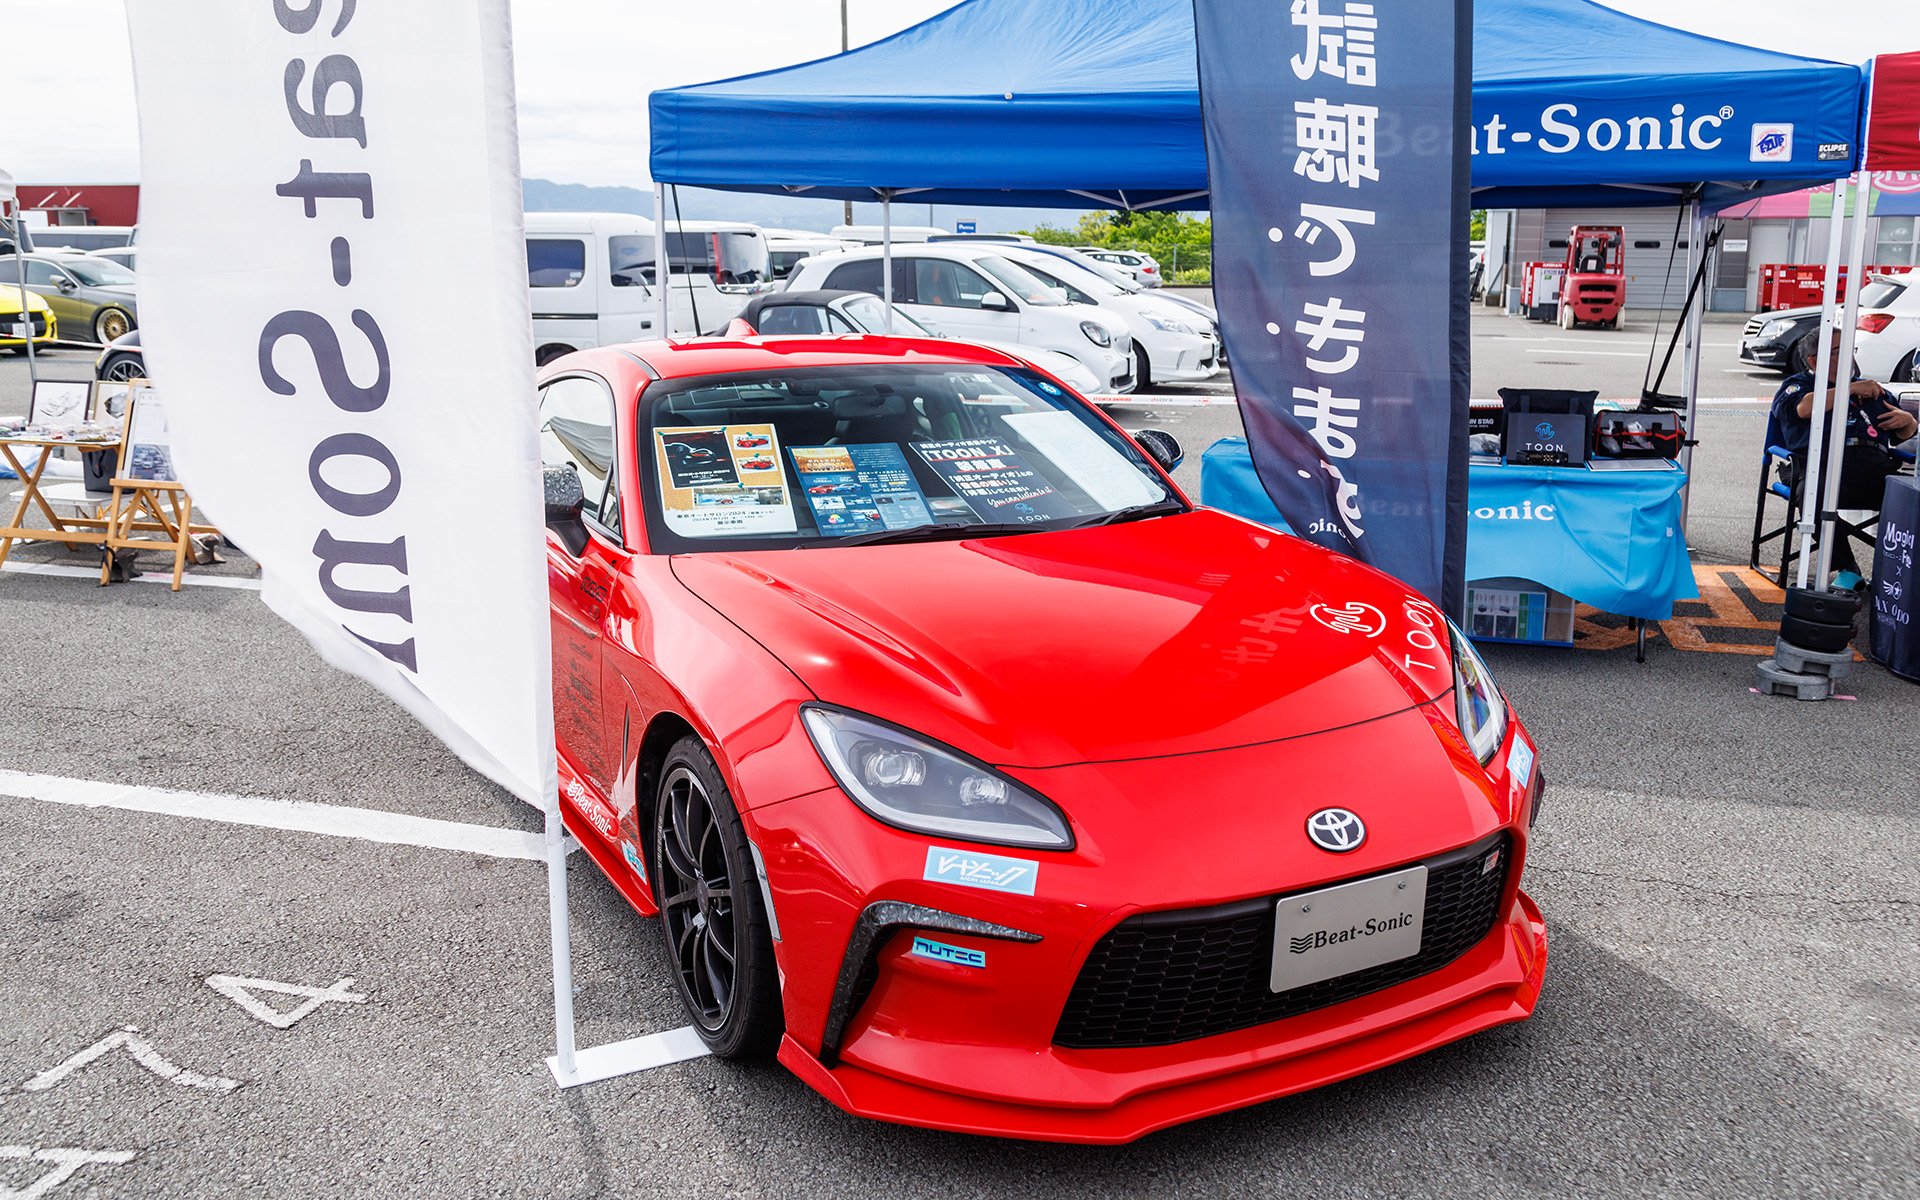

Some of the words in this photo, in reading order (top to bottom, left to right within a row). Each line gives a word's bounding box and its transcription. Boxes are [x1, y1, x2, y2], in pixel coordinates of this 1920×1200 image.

[1818, 144, 1847, 152] ECLIPSE
[1018, 513, 1051, 524] TOON
[580, 576, 607, 604] RAYS
[960, 876, 979, 884] AICHI
[979, 878, 1000, 886] JAPAN
[1314, 911, 1413, 950] Beat-Sonic
